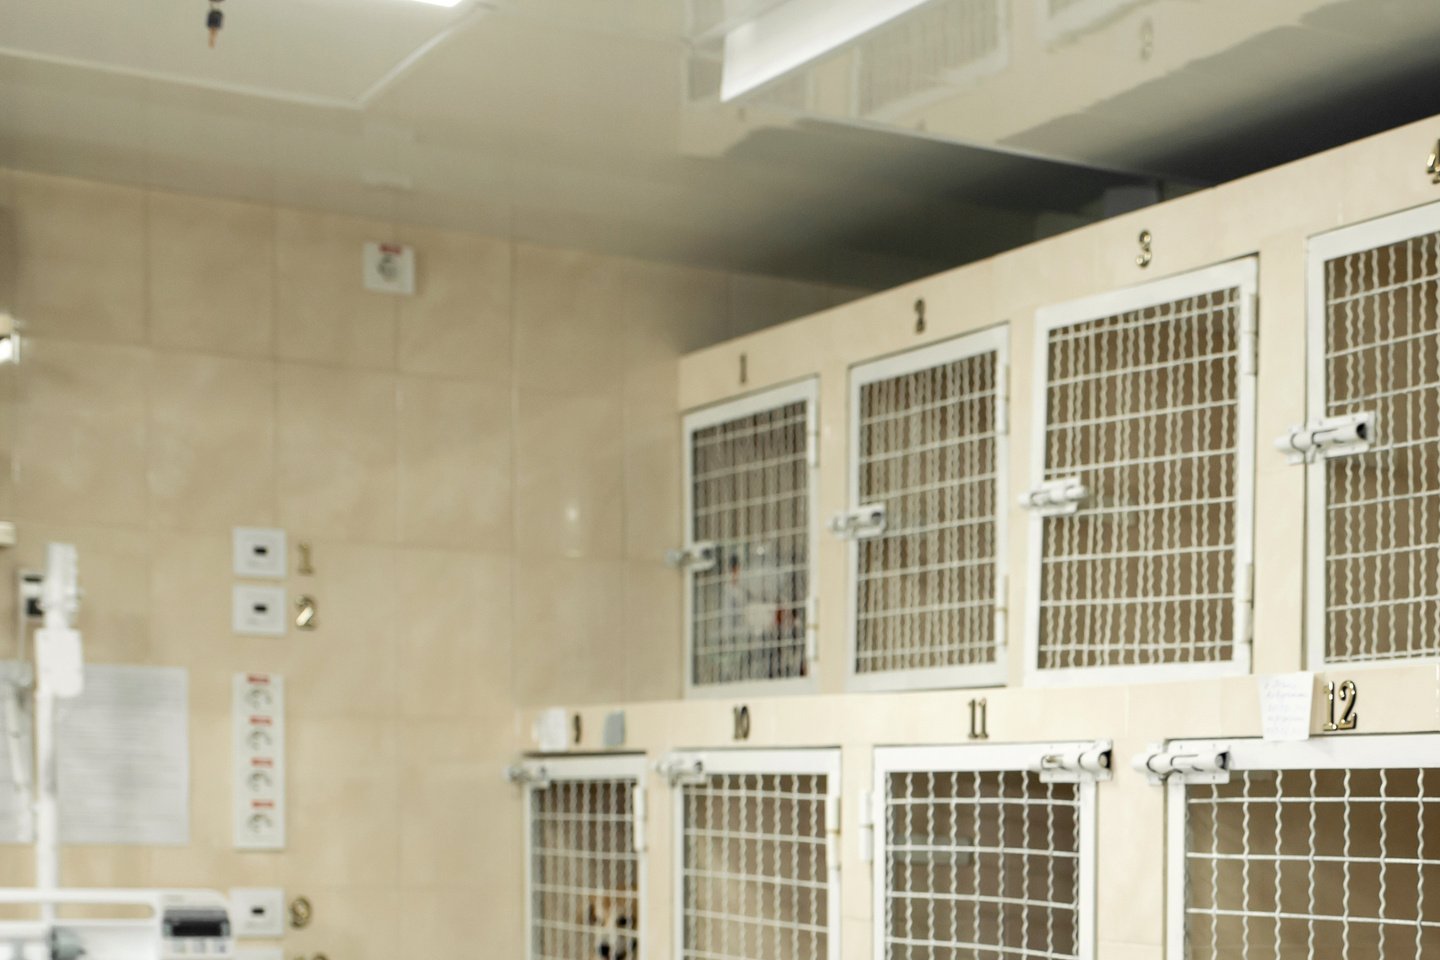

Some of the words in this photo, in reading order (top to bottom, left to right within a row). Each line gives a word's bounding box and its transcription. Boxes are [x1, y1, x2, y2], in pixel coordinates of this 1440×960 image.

[1136, 229, 1153, 268] 3
[295, 594, 318, 631] 2
[968, 698, 989, 739] 11
[1322, 680, 1358, 731] 12
